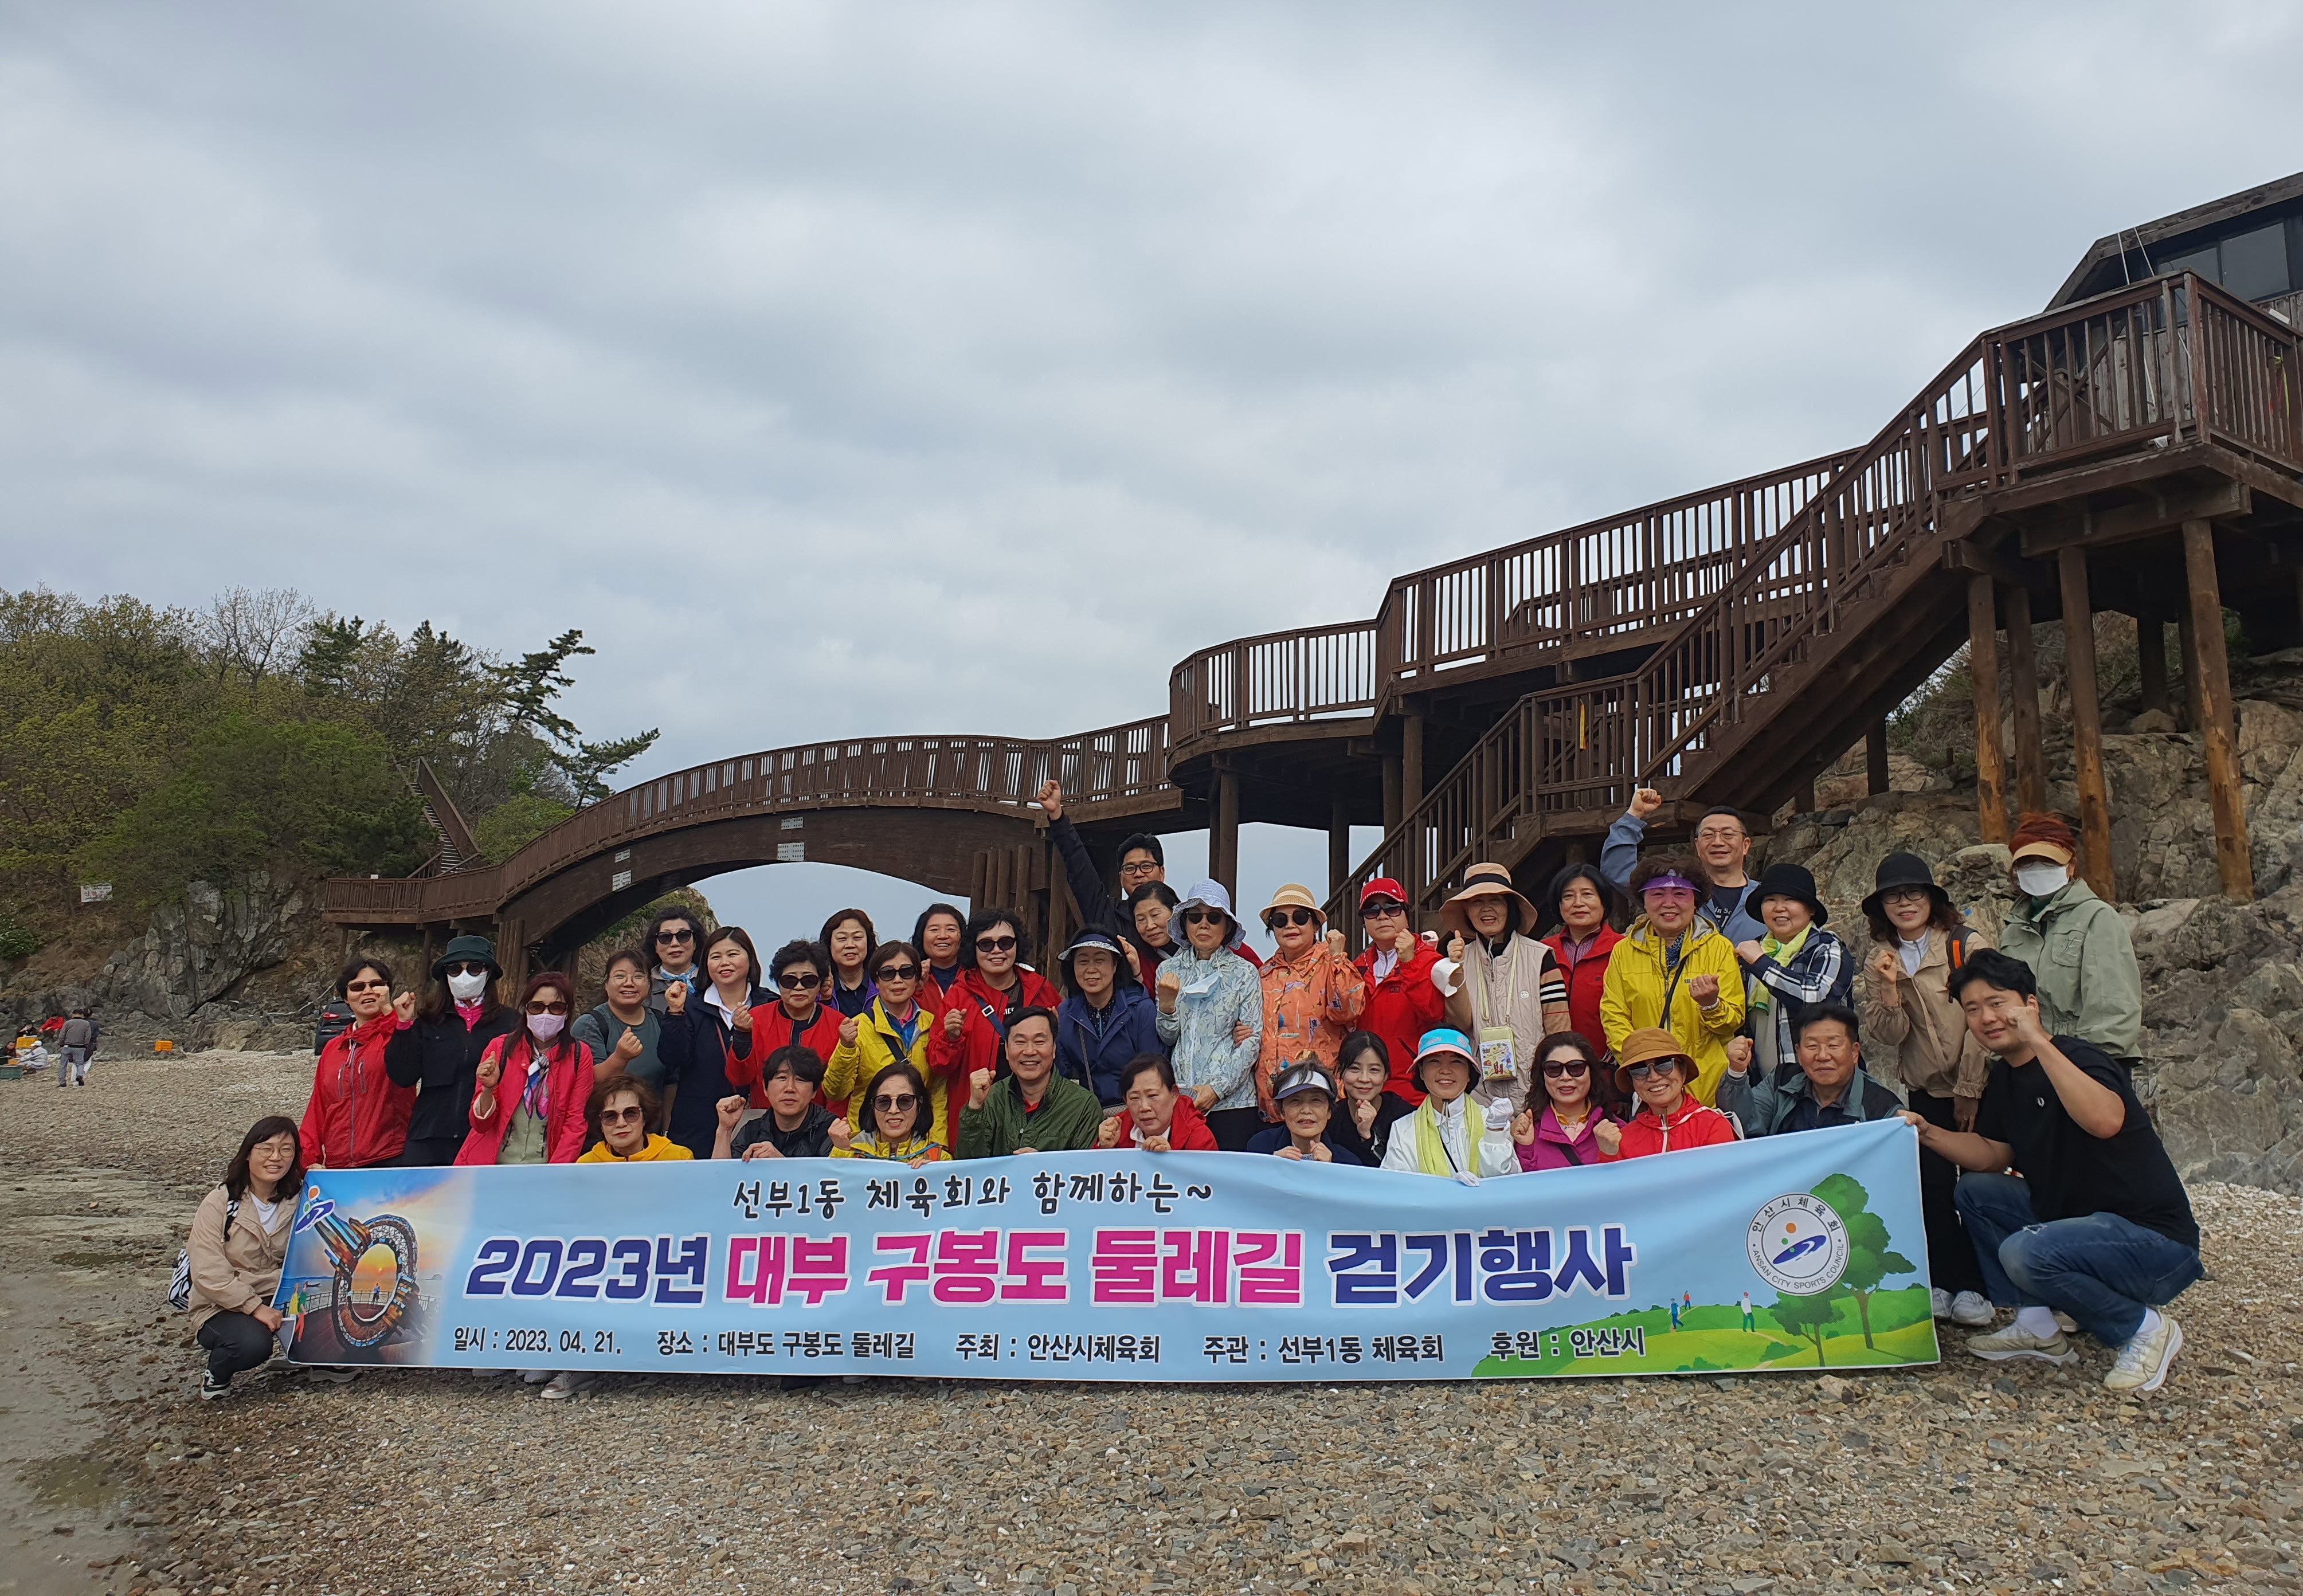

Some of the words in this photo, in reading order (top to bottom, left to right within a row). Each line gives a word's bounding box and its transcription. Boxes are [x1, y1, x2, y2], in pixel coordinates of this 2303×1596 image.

[733, 1180, 845, 1219] 선부1동
[865, 1174, 1011, 1218] 체육회와
[1752, 1197, 1840, 1232] 안산시체육회
[465, 1236, 708, 1304] 2023년
[726, 1236, 849, 1305] 대부
[868, 1230, 1067, 1304] 구봉도
[1091, 1230, 1302, 1304] 둘레길
[1327, 1227, 1633, 1304] 걷기행사
[1753, 1250, 1771, 1277] ANSAN
[1772, 1275, 1791, 1288] CITY
[1793, 1277, 1826, 1289] SPORTS
[1826, 1243, 1844, 1278] COUNCIL
[454, 1327, 486, 1352] 일시
[505, 1329, 552, 1353] 2023.
[559, 1330, 586, 1354] 04.
[594, 1330, 621, 1354] 21.
[656, 1330, 694, 1356] 장소
[718, 1331, 775, 1357] 대부도
[782, 1331, 844, 1358] 구봉도
[851, 1332, 915, 1359] 둘레길
[955, 1334, 1000, 1361] 주최
[1027, 1334, 1160, 1363] 안산시체육회
[1203, 1335, 1250, 1364] 주관
[1278, 1336, 1363, 1364] 선부1동
[1372, 1334, 1444, 1363] 체육회
[1490, 1331, 1540, 1360] 후원
[1570, 1327, 1644, 1357] 안산시
